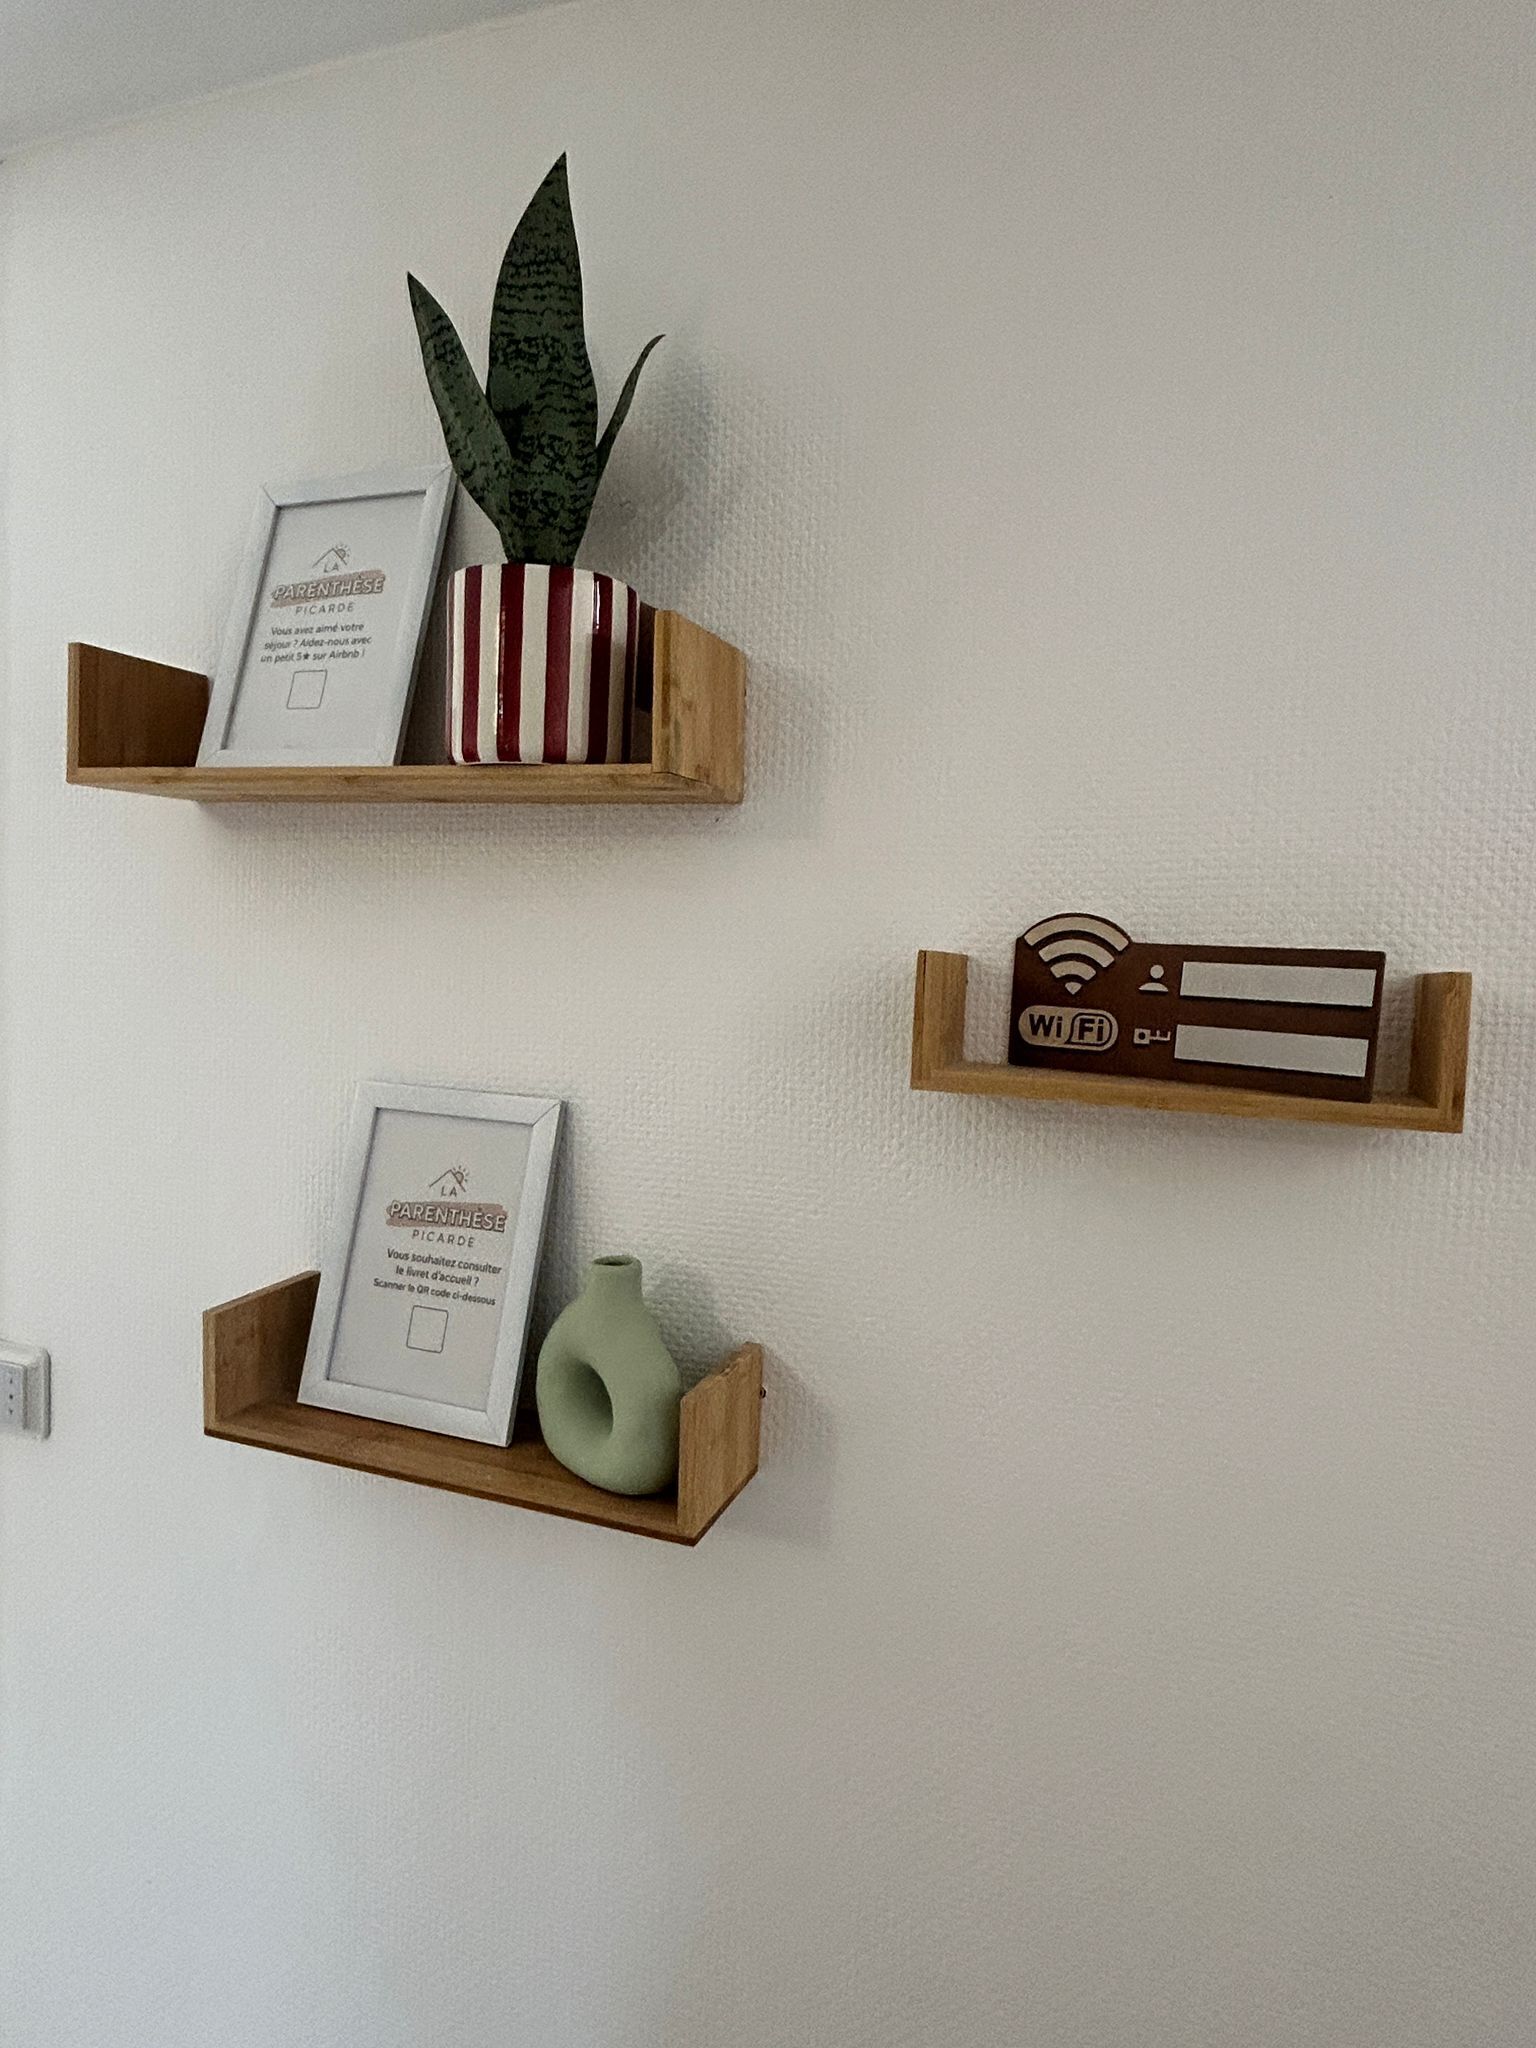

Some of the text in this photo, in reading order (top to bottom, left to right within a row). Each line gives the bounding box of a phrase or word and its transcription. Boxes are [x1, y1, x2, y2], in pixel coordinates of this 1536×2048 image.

[324, 563, 339, 573] LA
[295, 602, 355, 615] PICARDE
[272, 624, 364, 636] Vous avez aimé votre
[264, 642, 291, 651] séjour
[300, 637, 349, 647] Aidez-nous
[351, 637, 372, 645] avec
[274, 653, 295, 664] petit
[328, 650, 360, 659] Airbnb
[441, 1186, 457, 1197] LA
[412, 1230, 475, 1247] PICARDE
[387, 1248, 502, 1274] Vous souhaitez consulter
[396, 1265, 405, 1274] le
[407, 1266, 429, 1279] livret
[373, 1278, 496, 1306] Scanner le QR code ci-dessous
